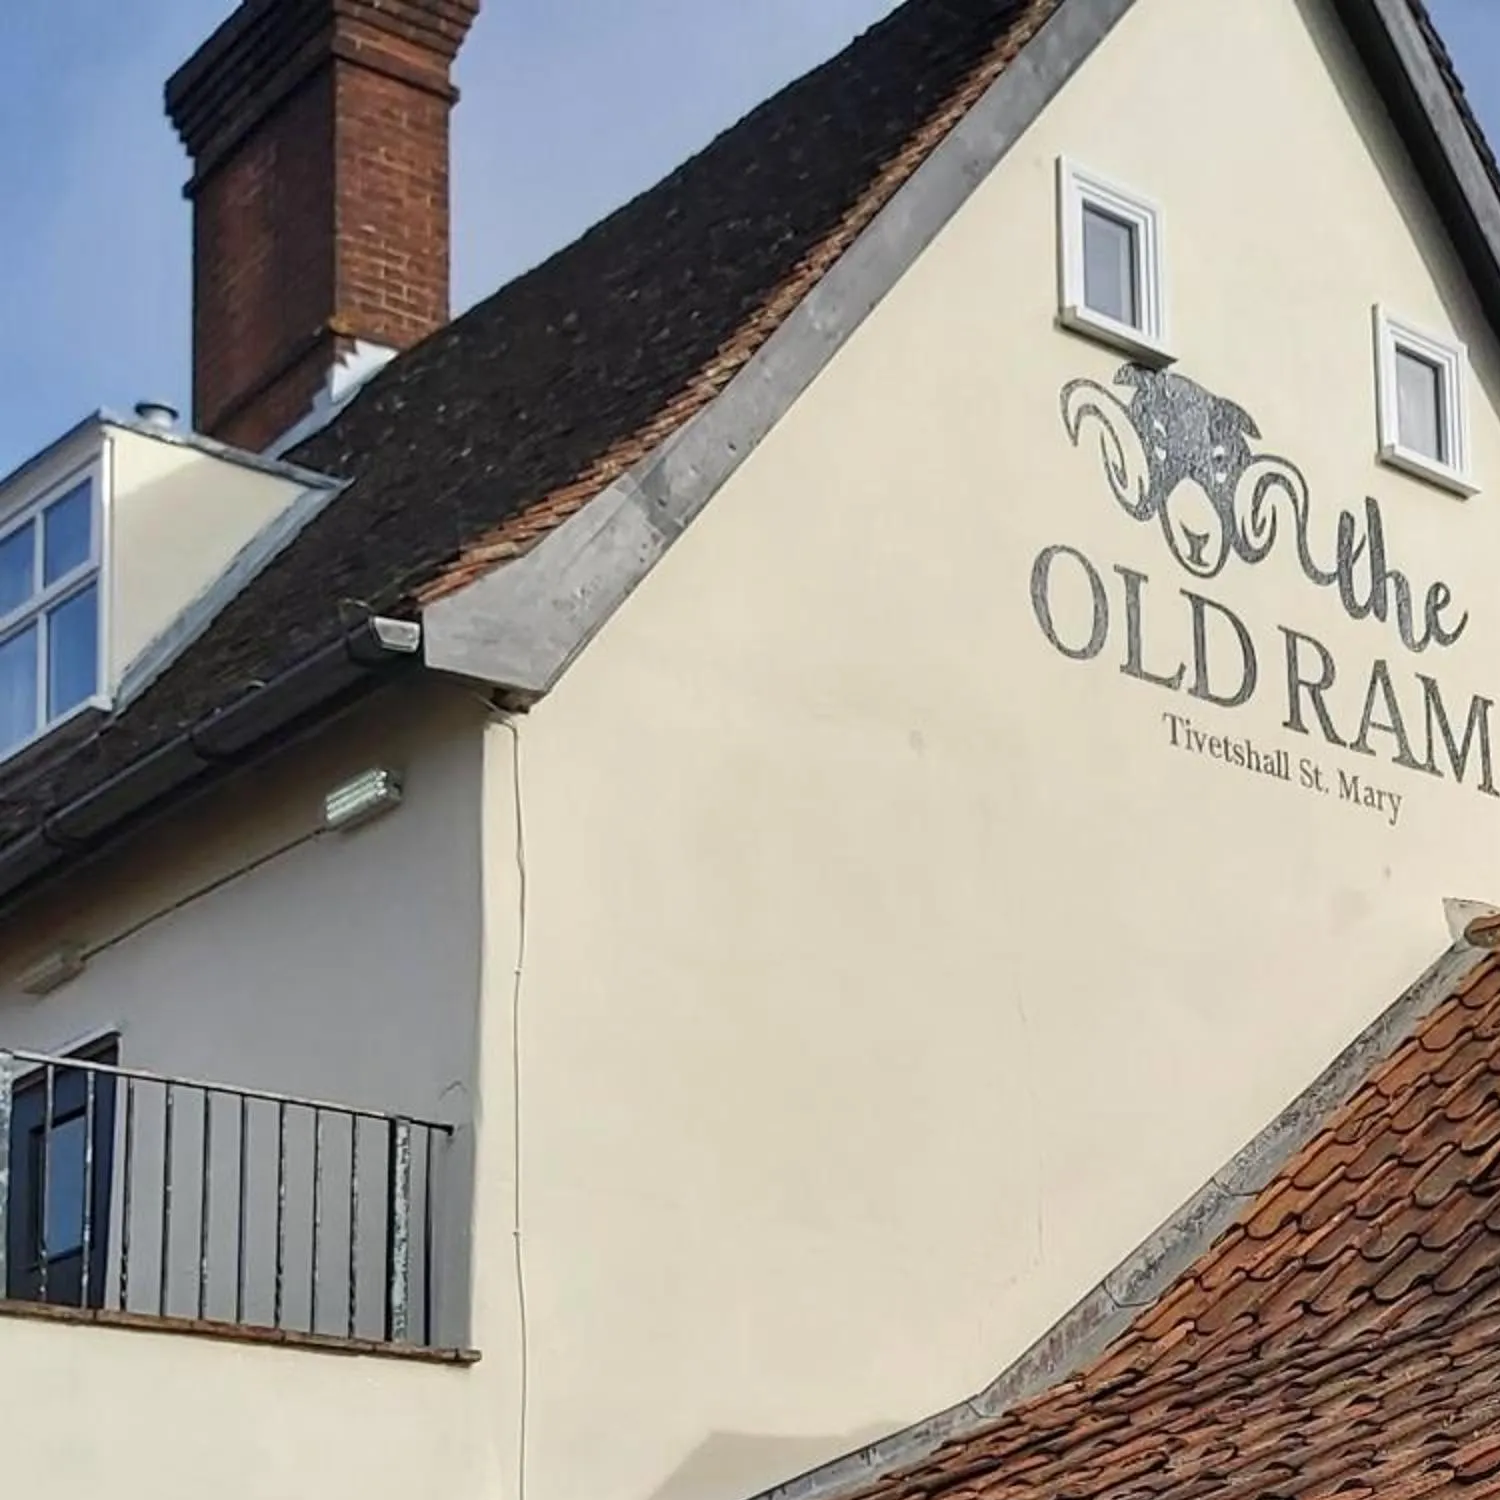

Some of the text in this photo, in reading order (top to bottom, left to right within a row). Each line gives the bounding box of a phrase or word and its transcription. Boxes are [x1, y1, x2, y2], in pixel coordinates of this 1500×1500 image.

[1029, 543, 1259, 709] OLD
[1336, 496, 1469, 654] the
[1162, 711, 1403, 826] Tivetshall St. Mary
